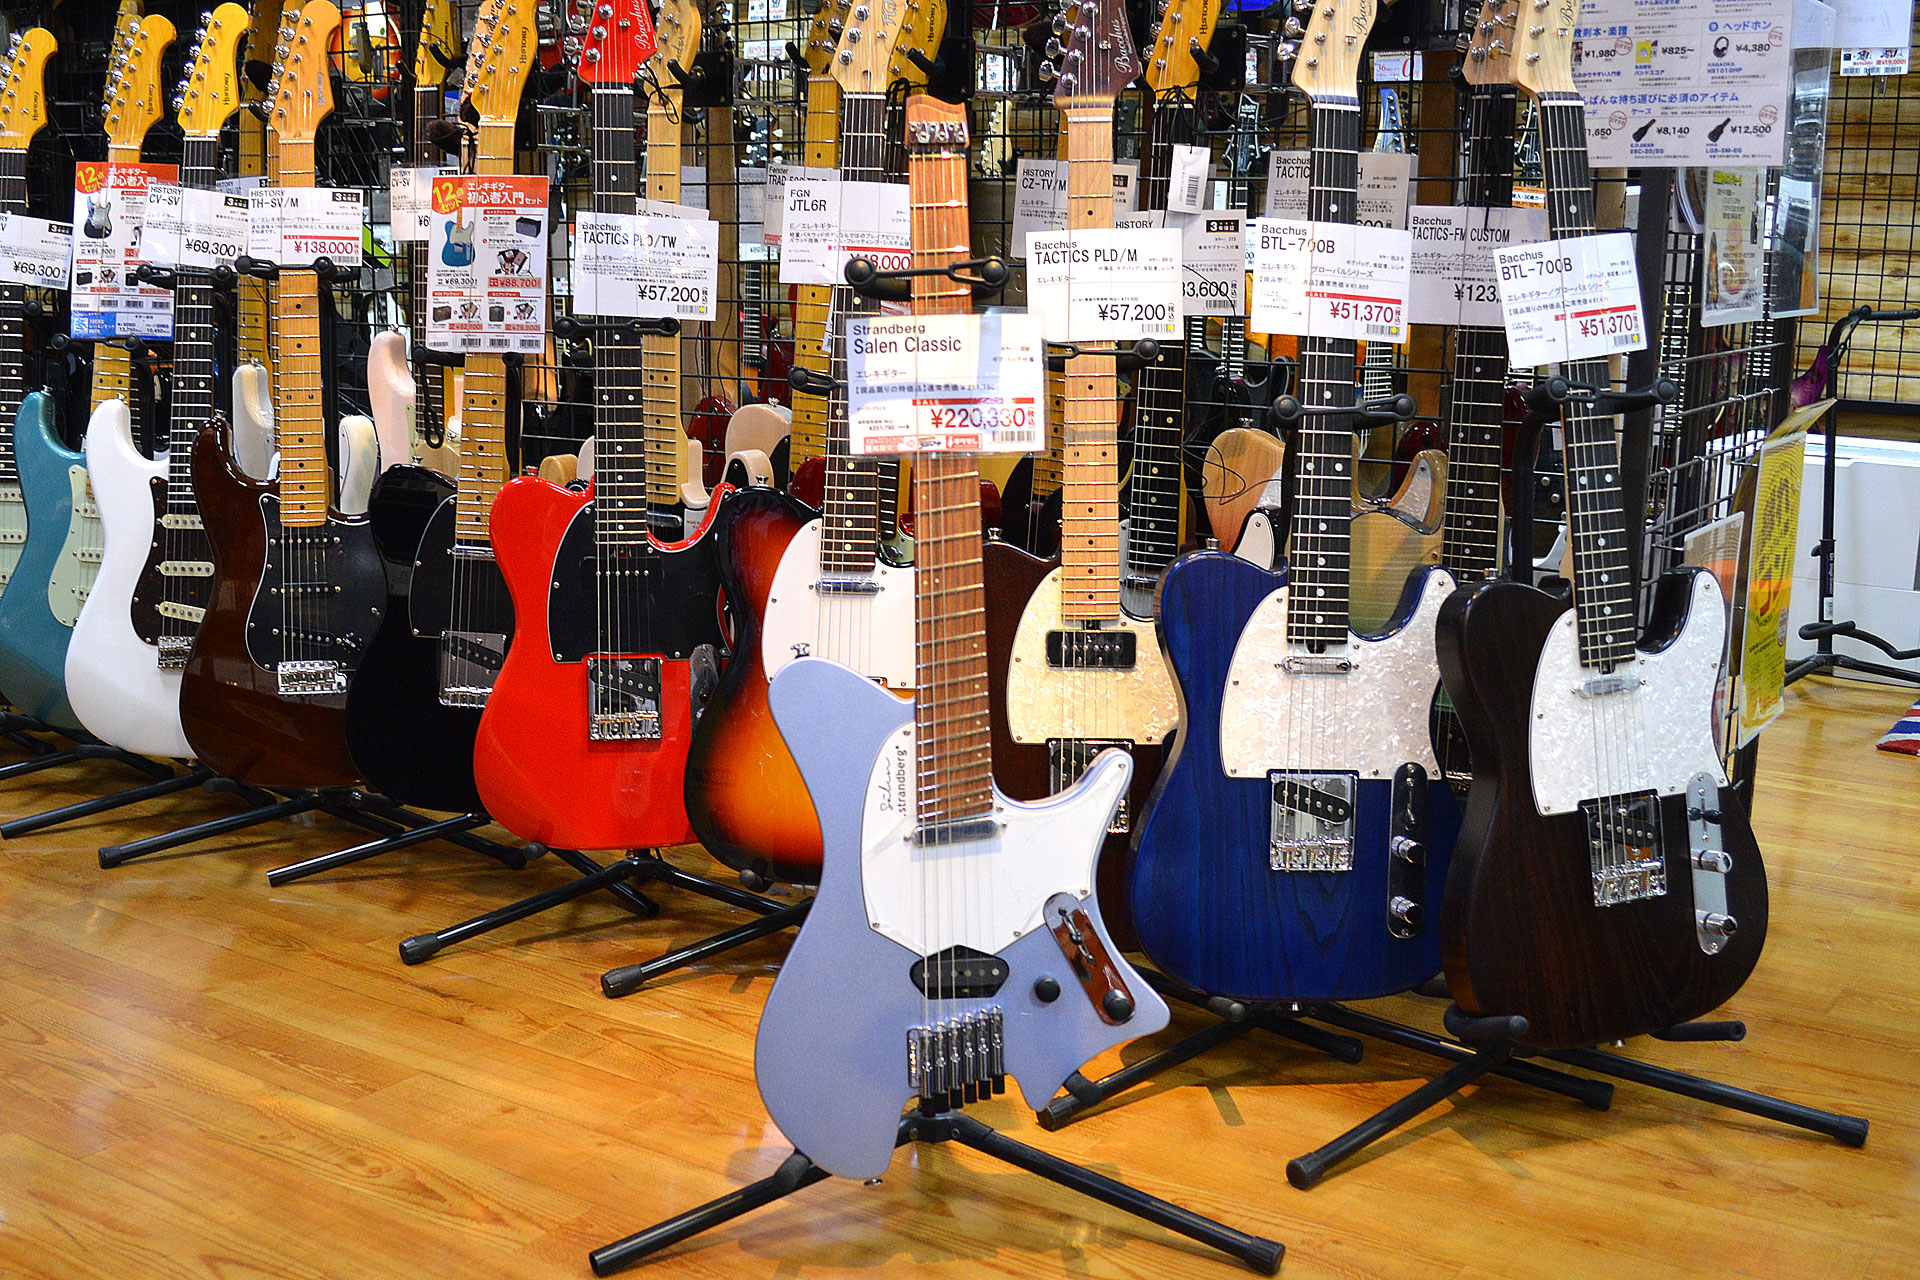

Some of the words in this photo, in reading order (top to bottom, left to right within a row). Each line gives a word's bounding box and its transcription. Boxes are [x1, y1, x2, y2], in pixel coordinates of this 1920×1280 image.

[1723, 21, 1772, 31] ヘッドホン
[1109, 19, 1132, 73] Bacchus
[1735, 43, 1771, 52] ¥4,380
[1584, 49, 1616, 58] ¥1,980
[1585, 128, 1612, 137] 1,650
[1656, 127, 1690, 135] ¥8,140
[1730, 126, 1772, 135] ¥12,500
[1276, 156, 1310, 165] Bacchus
[769, 166, 788, 175] Fender
[1022, 168, 1055, 178] HISTORY
[1276, 165, 1310, 178] TACTIC
[150, 186, 182, 196] HISTORY
[467, 182, 514, 191] エレキギター
[1022, 178, 1067, 191] CZ-TV/M
[149, 193, 180, 206] CV-SV
[250, 189, 286, 198] HISTORY
[467, 190, 543, 206] 初心者入門セット
[790, 189, 810, 198] FGN
[251, 198, 299, 209] TH-SV/M
[789, 199, 827, 212] JTL6R
[582, 222, 622, 232] Bacchus
[1115, 220, 1153, 229] HISTORY
[1412, 216, 1452, 226] Bacchus
[1261, 224, 1307, 236] Bacchus
[1470, 227, 1510, 243] CUSTOM
[583, 231, 629, 245] TACTICS
[185, 238, 236, 257] ¥69,300
[294, 240, 354, 255] ¥138,000
[1034, 241, 1078, 251] Bacchus
[1261, 236, 1335, 254] BTL-700B
[850, 253, 911, 270] 8,000
[1035, 248, 1090, 265] TACTICS
[1094, 248, 1138, 263] PLD/M
[1411, 251, 1494, 260] エレキギター／クラフトシリー
[1499, 251, 1544, 264] Bacchus
[13, 260, 61, 279] ¥69,300
[1501, 257, 1573, 281] BTL-700B
[500, 277, 537, 288] ¥88,700
[638, 284, 700, 303] ¥57,200
[1454, 283, 1501, 304] ¥123,
[1098, 303, 1166, 322] ¥57,200
[1330, 301, 1394, 323] ¥51,370
[853, 323, 926, 336] Strandberg
[1579, 314, 1633, 338] ¥51,370
[854, 338, 898, 354] Salen
[904, 336, 962, 352] Classic
[855, 369, 907, 379] エレキギター
[931, 407, 1025, 429] ¥220,330
